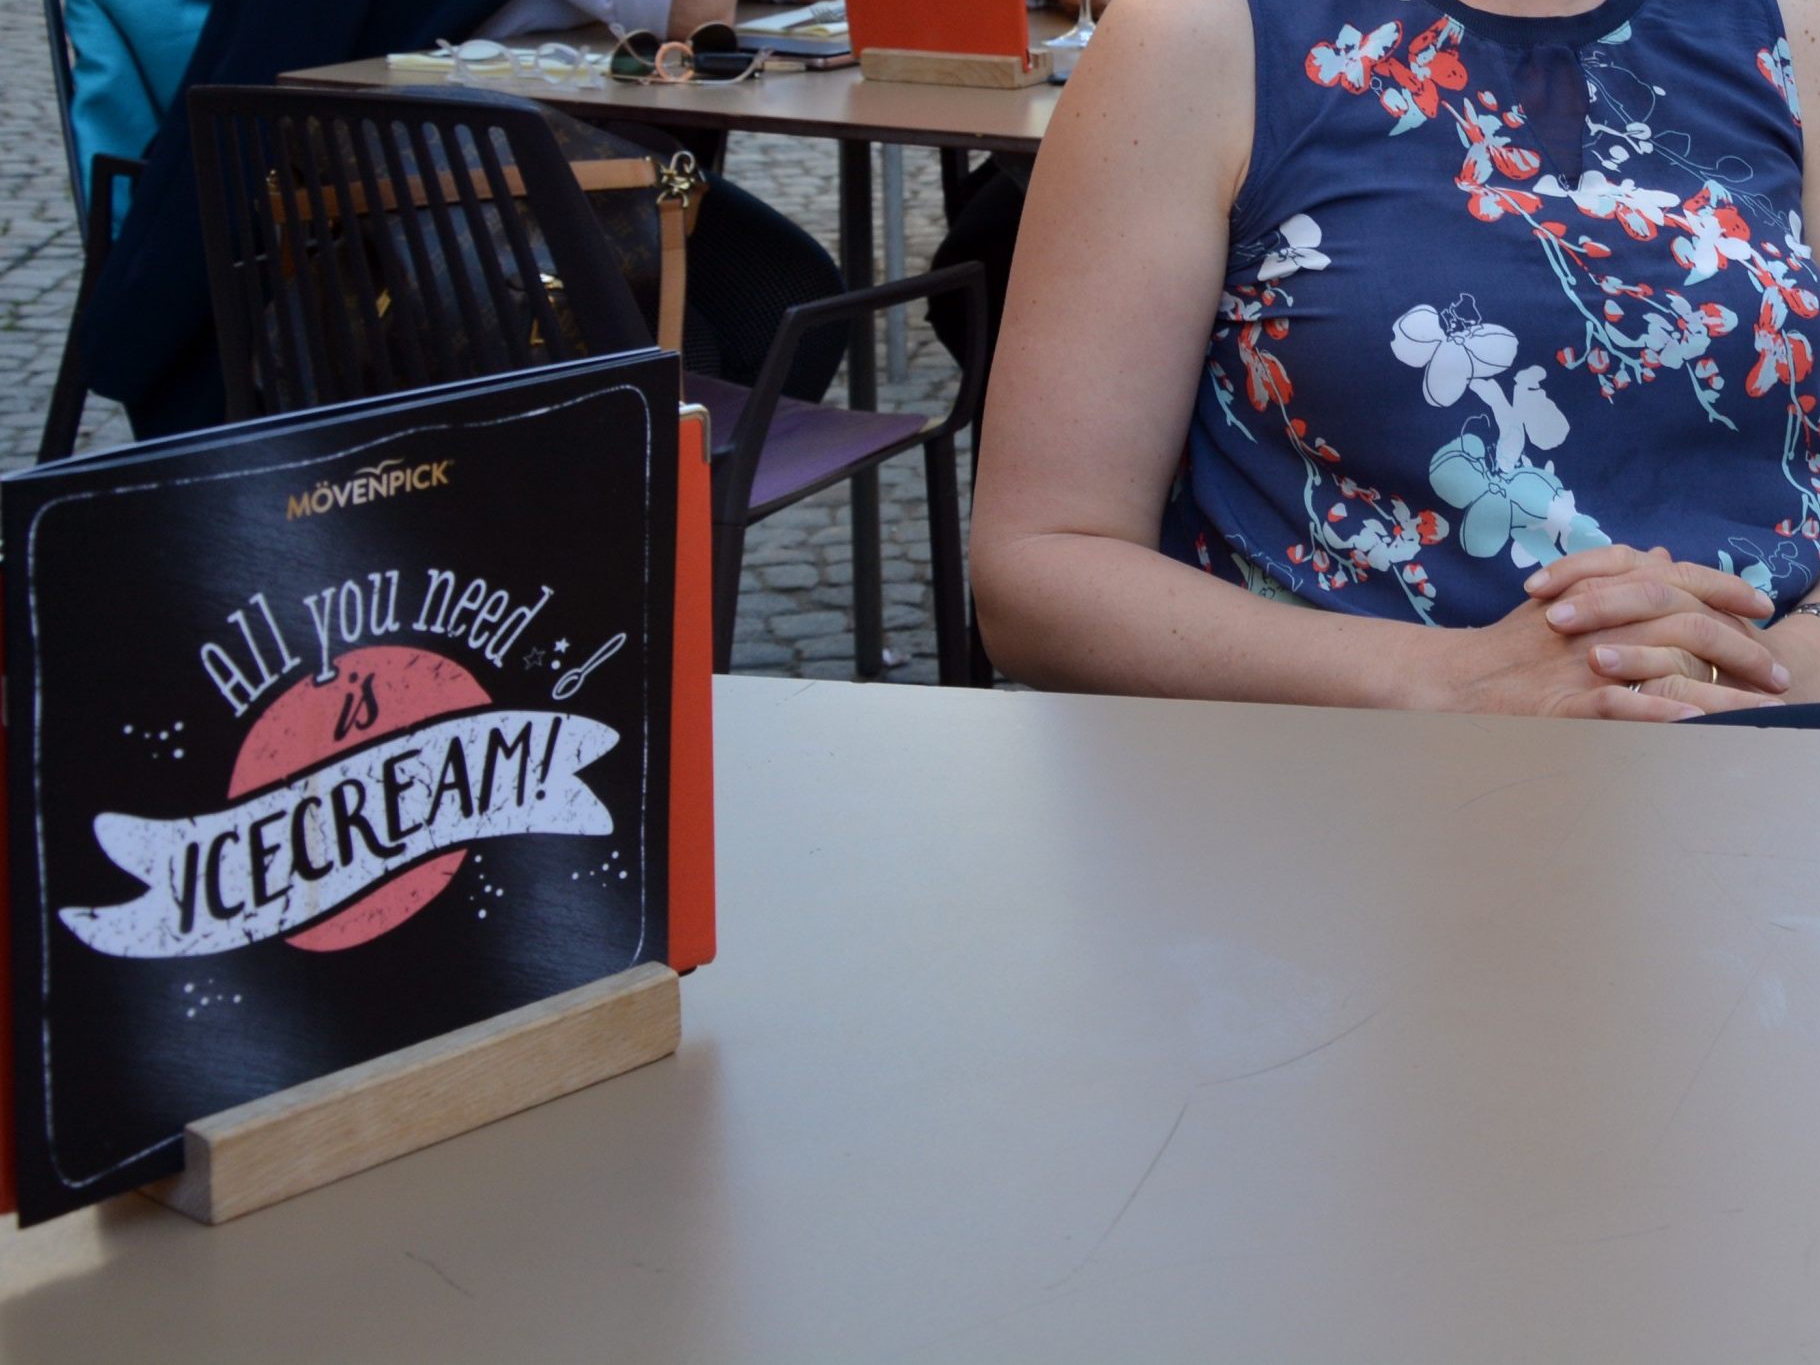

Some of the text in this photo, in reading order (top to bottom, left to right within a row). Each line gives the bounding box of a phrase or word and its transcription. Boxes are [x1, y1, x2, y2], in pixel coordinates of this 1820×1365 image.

[286, 459, 450, 522] MÖVENPICK
[200, 567, 555, 717] All you need
[333, 671, 379, 742] is
[177, 715, 563, 934] ICECREAM!
